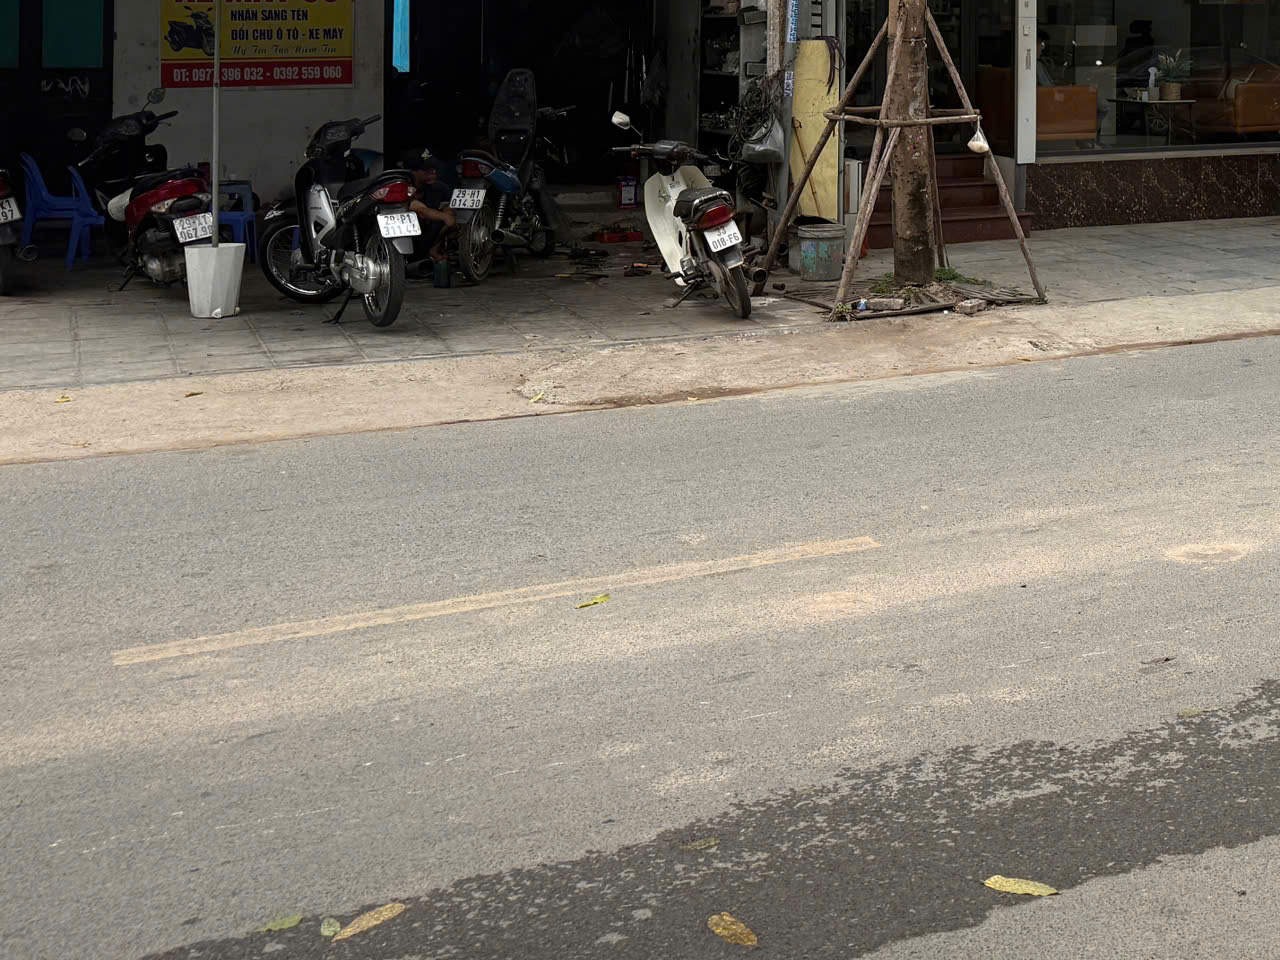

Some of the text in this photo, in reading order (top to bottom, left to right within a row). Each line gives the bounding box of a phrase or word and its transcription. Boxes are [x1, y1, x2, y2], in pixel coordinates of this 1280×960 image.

[261, 9, 288, 21] SANG
[309, 28, 320, 40] XE
[173, 68, 190, 82] ĐT:
[222, 68, 241, 81] 396
[243, 67, 263, 80] 032
[273, 67, 299, 80] 0392
[302, 66, 320, 79] 559
[323, 66, 341, 79] 060
[456, 189, 480, 198] 29-H1
[451, 198, 481, 208] 014.30
[384, 214, 412, 225] 29-P1
